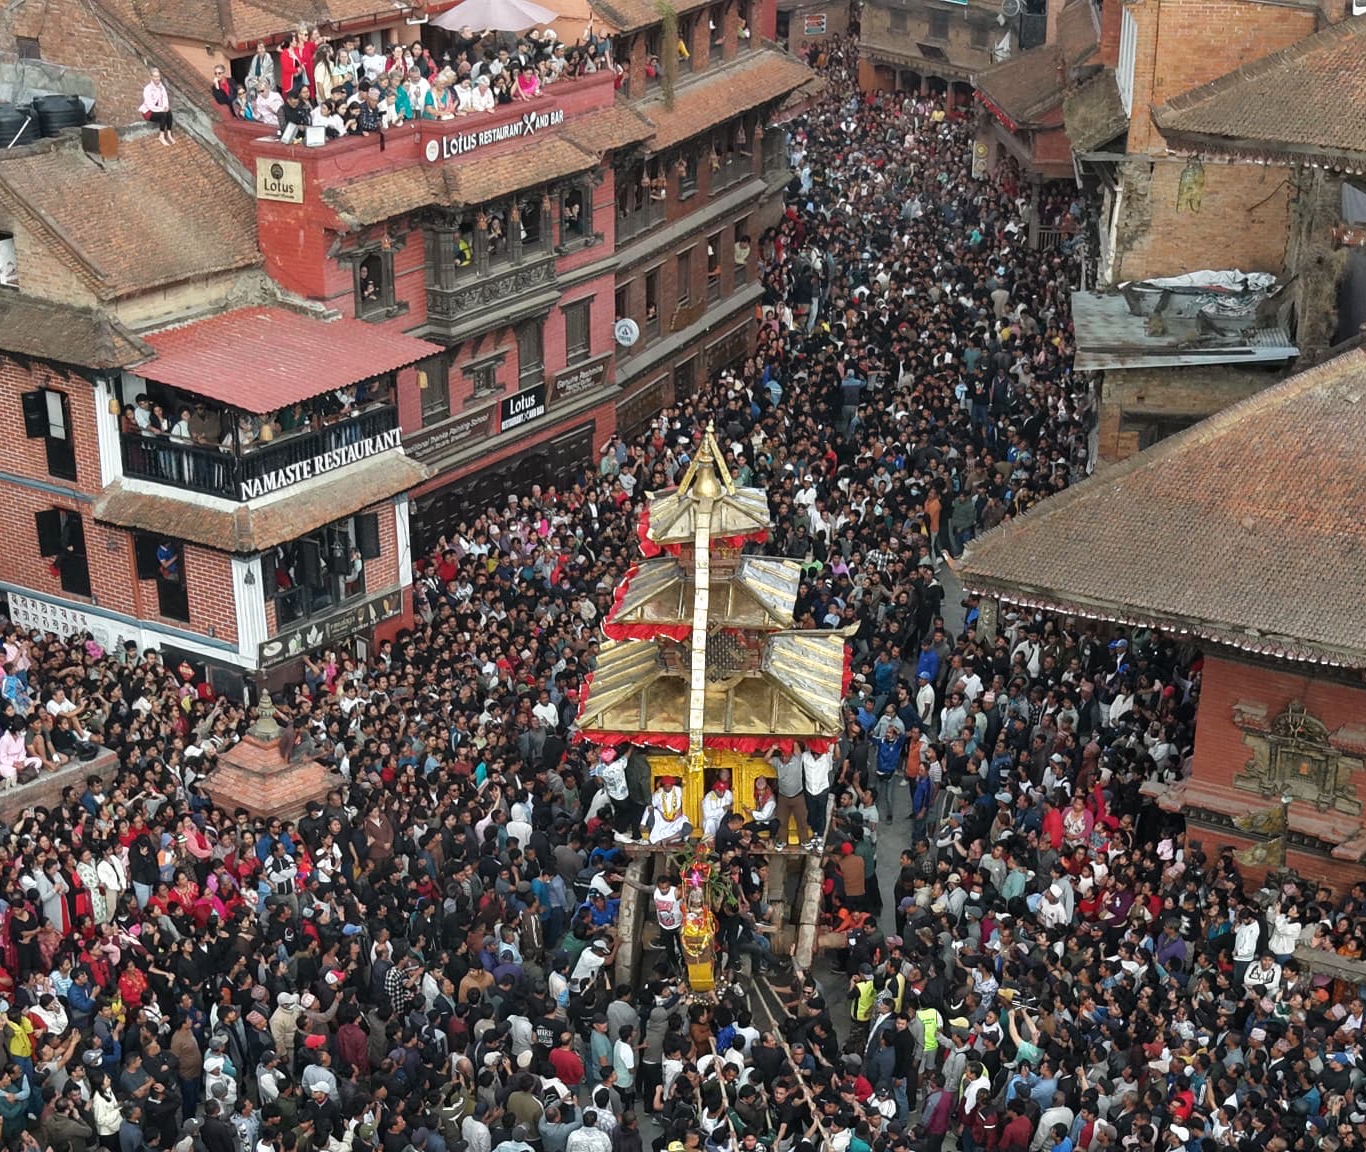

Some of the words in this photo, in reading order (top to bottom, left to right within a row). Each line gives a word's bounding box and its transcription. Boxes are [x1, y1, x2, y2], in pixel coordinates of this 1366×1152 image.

[442, 132, 477, 159] Lotus
[479, 121, 523, 146] RESTAURANT
[535, 115, 549, 130] AND
[550, 109, 564, 125] BAR
[510, 394, 536, 415] Lotus
[240, 459, 312, 501] NAMASTE
[314, 427, 403, 474] RESTAURANT
